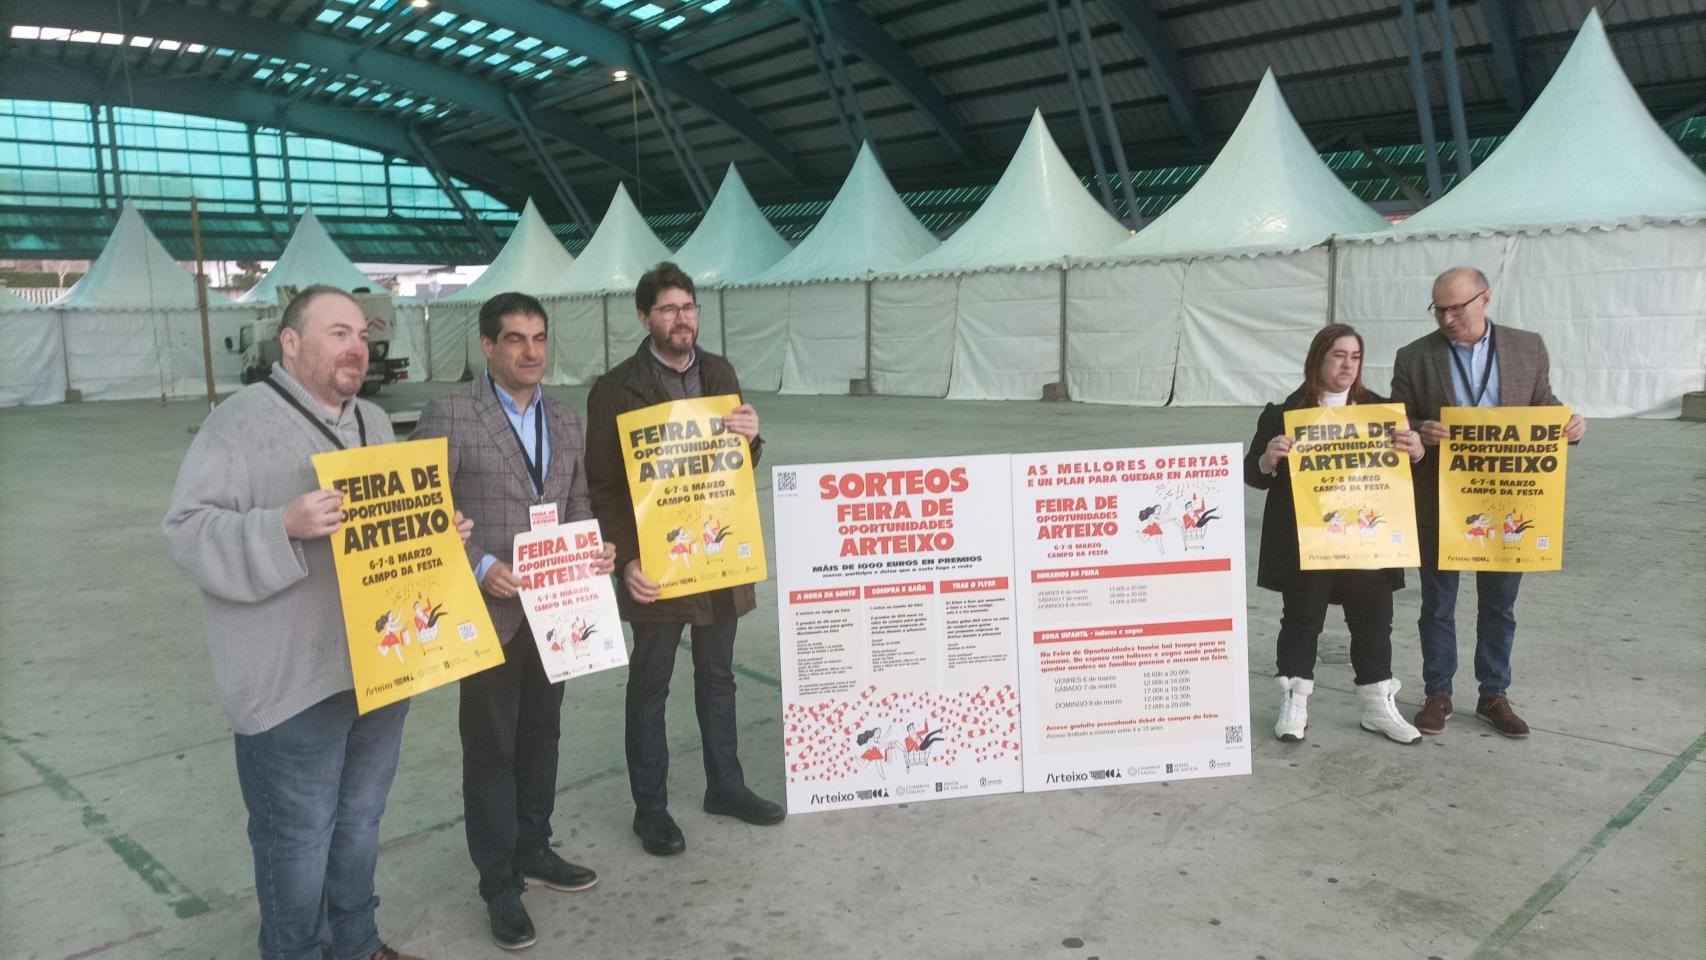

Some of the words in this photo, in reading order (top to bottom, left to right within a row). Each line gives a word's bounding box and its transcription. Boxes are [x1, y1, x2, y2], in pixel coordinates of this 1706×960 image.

[630, 419, 701, 448] FEIRA
[1294, 424, 1359, 442] FEIRA
[1368, 421, 1396, 439] DE
[1449, 425, 1520, 441] FEIRA
[1531, 425, 1561, 441] DE
[634, 437, 741, 460] OPORTUNIDADES
[1450, 443, 1558, 453] OPORTUNIDADES
[640, 451, 744, 483] ARTEIXO
[1028, 465, 1048, 476] AS
[1058, 459, 1146, 474] MELLORES
[1155, 455, 1229, 469] OFERTAS
[1299, 452, 1399, 472] ARTEIXO
[1449, 455, 1557, 473] ARTEIXO
[333, 470, 405, 502] FEIRA
[411, 464, 441, 492] DE
[692, 480, 725, 491] MARZO
[819, 467, 969, 500] SORTEOS
[1028, 479, 1034, 487] E
[1038, 478, 1052, 486] UN
[1057, 476, 1085, 485] PLAN
[1089, 474, 1117, 483] PARA
[1121, 472, 1163, 482] QUEDAR
[1167, 471, 1181, 479] EN
[1185, 469, 1228, 478] ARTEIXO
[1365, 483, 1390, 491] FESTA
[1461, 487, 1496, 495] CAMPO
[657, 495, 690, 507] CAMPO
[709, 489, 735, 498] FESTA
[1035, 497, 1088, 513] FEIRA
[1095, 496, 1117, 510] DE
[341, 492, 443, 523] OPORTUNIDADES
[837, 501, 911, 522] FEIRA
[922, 498, 953, 517] DE
[1037, 511, 1118, 523] OPORTUNIDADES
[344, 509, 449, 555] ARTEIXO
[838, 519, 953, 535] OPORTUNIDADES
[1038, 522, 1118, 540] ARTEIXO
[518, 536, 568, 561] FEIRA
[574, 531, 598, 548] DE
[840, 532, 954, 557] ARTEIXO
[1075, 542, 1102, 550] MARZO
[369, 555, 395, 570] 6-7-8
[398, 547, 432, 563] MARZO
[813, 564, 838, 572] MÁIS
[886, 560, 918, 568] EUROS
[938, 555, 982, 564] PREMIOS
[1047, 551, 1073, 559] CAMPO
[363, 569, 397, 586] CAMPO
[402, 566, 414, 576] DA
[417, 558, 443, 574] FESTA
[560, 587, 589, 598] MARZO
[804, 591, 822, 599] HORA
[534, 601, 559, 612] CAMPO
[562, 598, 573, 607] DA
[576, 593, 599, 604] FESTA
[1061, 631, 1089, 639] INFANTIL
[1084, 645, 1135, 655] Oportunidades
[1054, 676, 1082, 685] VENRES
[1055, 683, 1083, 693] SÁBADO
[1055, 700, 1087, 710] DOMINGO
[1046, 772, 1088, 783] Arteixo
[811, 792, 854, 805] Arteixo
